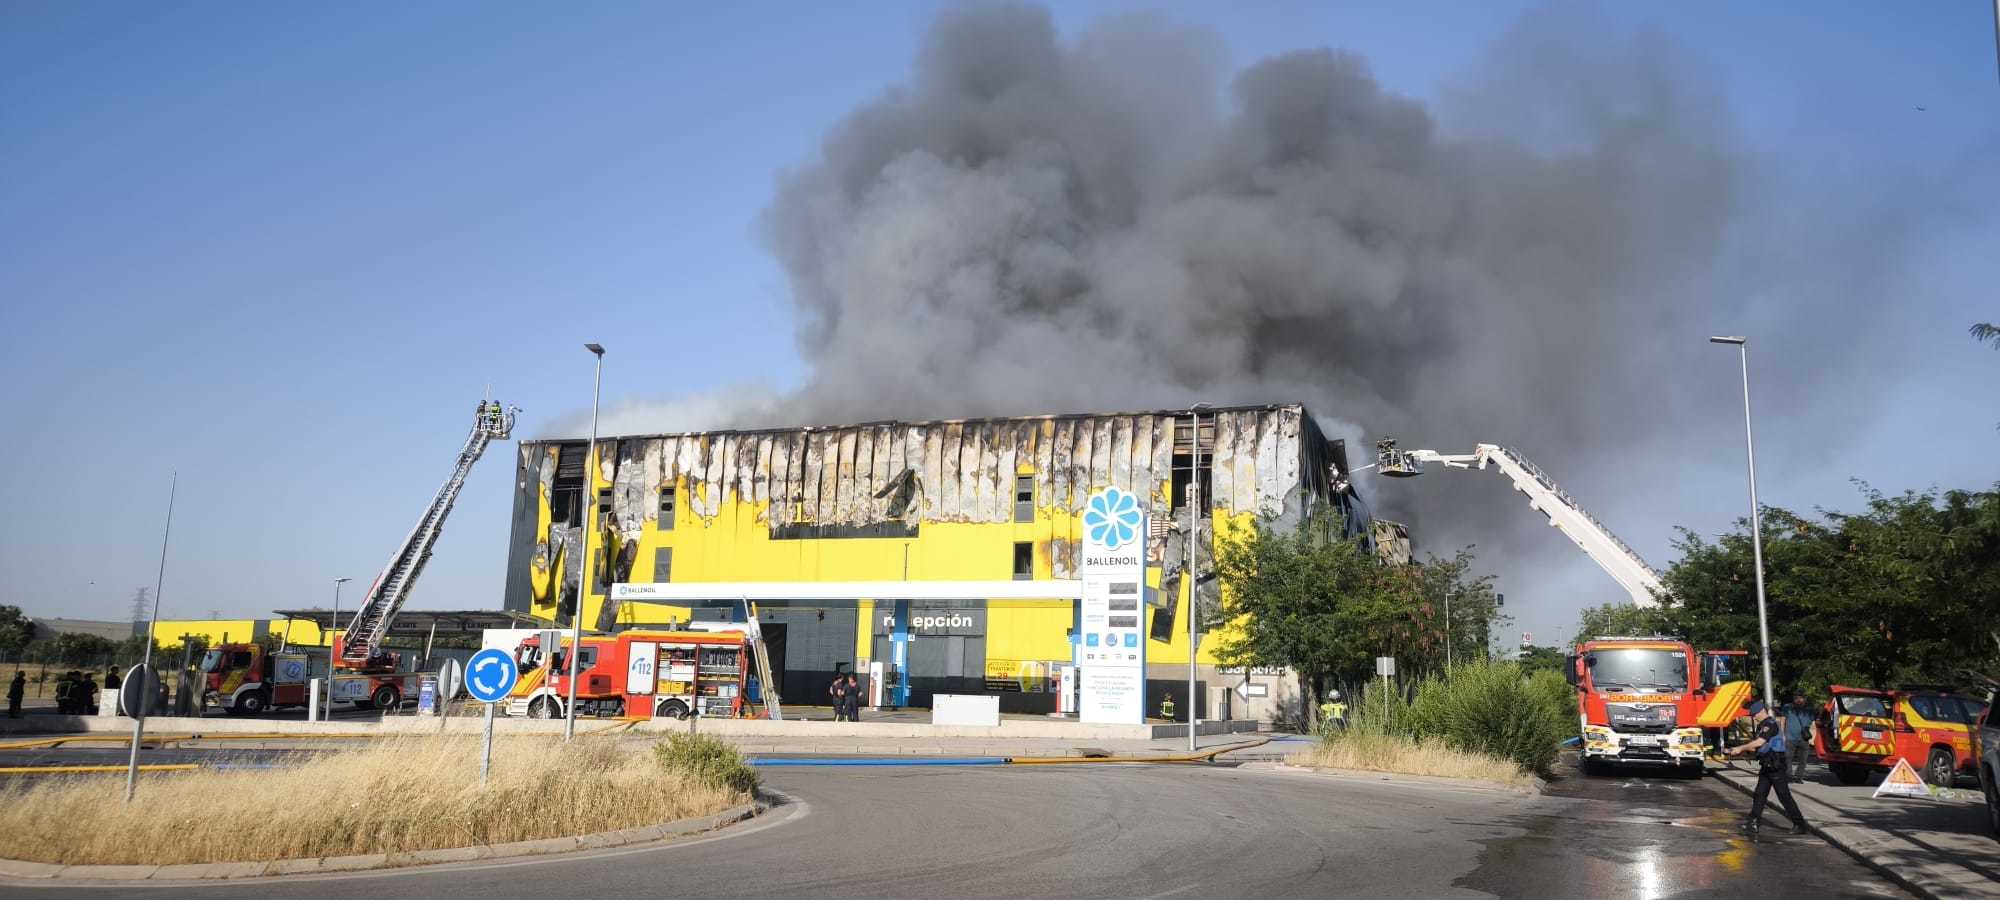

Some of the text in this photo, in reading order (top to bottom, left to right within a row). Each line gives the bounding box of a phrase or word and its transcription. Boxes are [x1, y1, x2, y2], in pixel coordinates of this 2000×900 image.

[1087, 556, 1138, 566] BALLENOIL
[883, 613, 973, 630] repción
[638, 663, 652, 675] 112
[350, 683, 362, 695] 112
